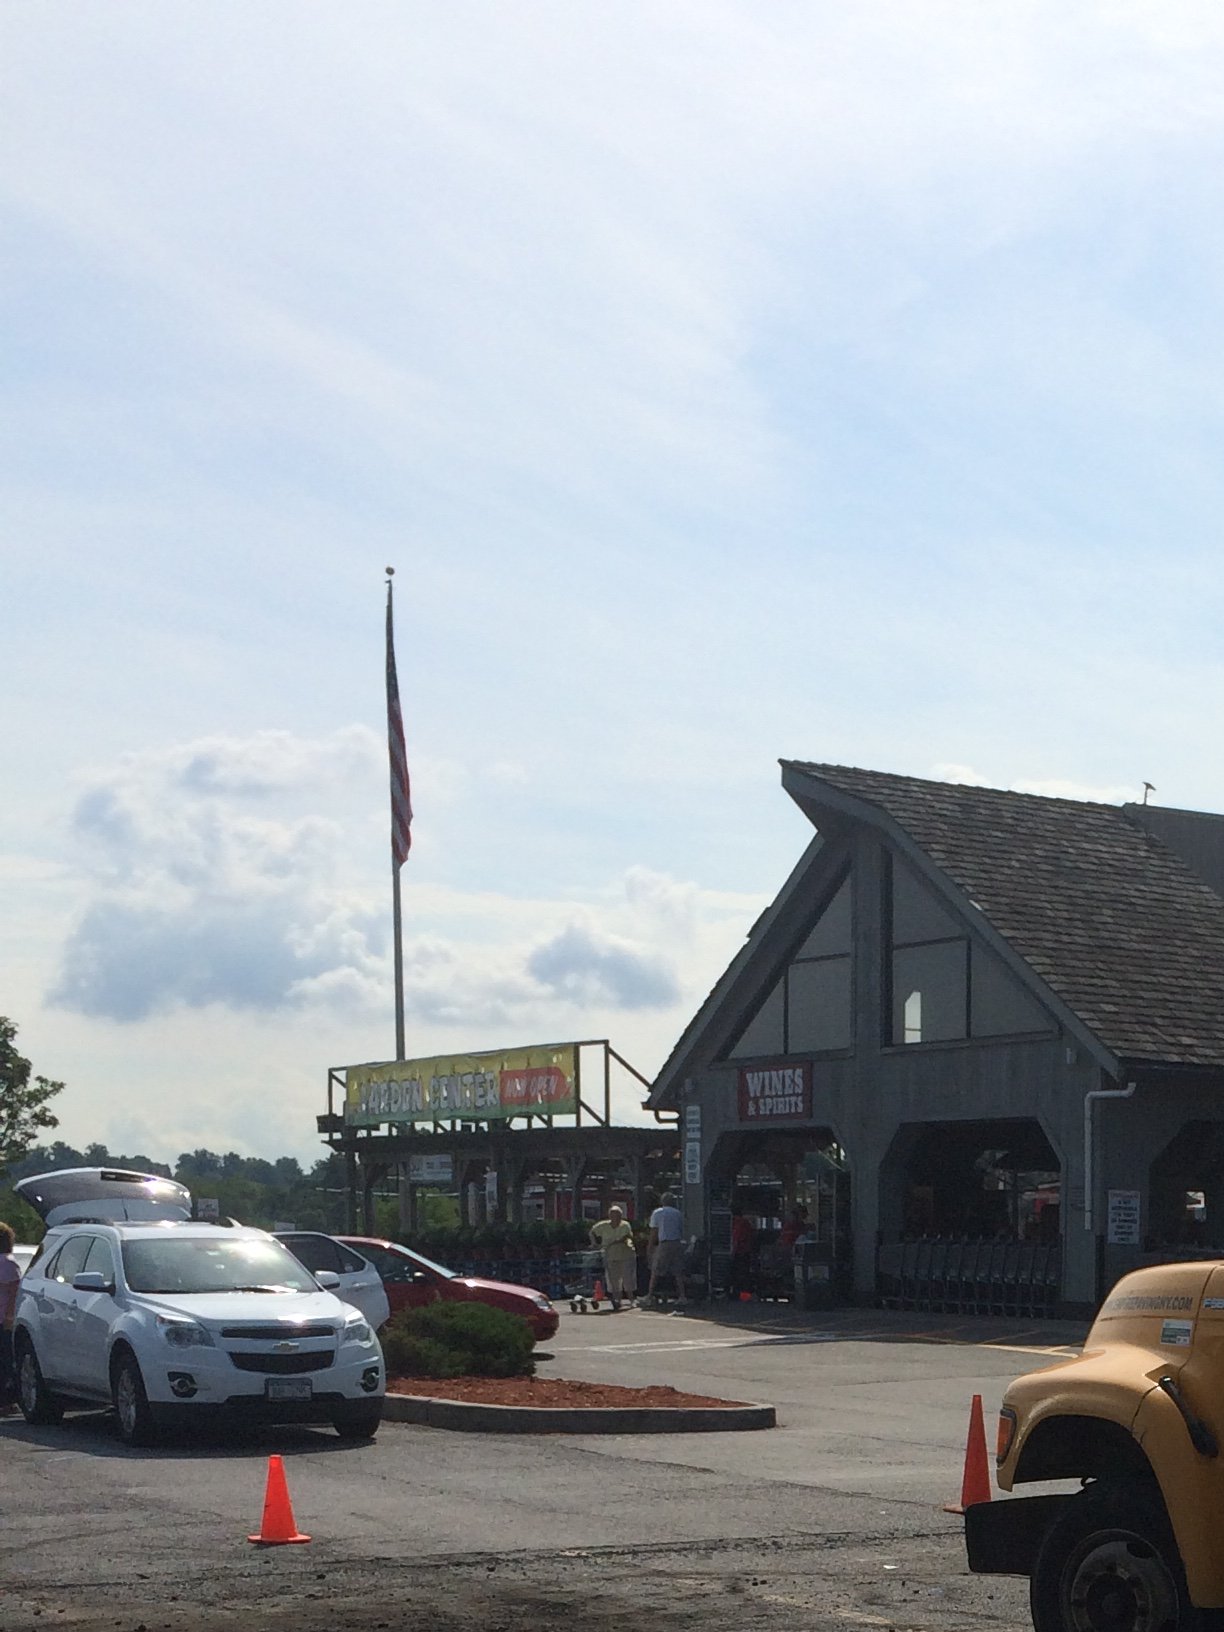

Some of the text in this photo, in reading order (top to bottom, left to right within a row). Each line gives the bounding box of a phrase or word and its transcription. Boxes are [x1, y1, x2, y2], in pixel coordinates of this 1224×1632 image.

[429, 1070, 499, 1112] CENTER
[530, 1075, 558, 1097] OPEN
[746, 1068, 803, 1098] WINES
[747, 1096, 803, 1116] & SPIRITS
